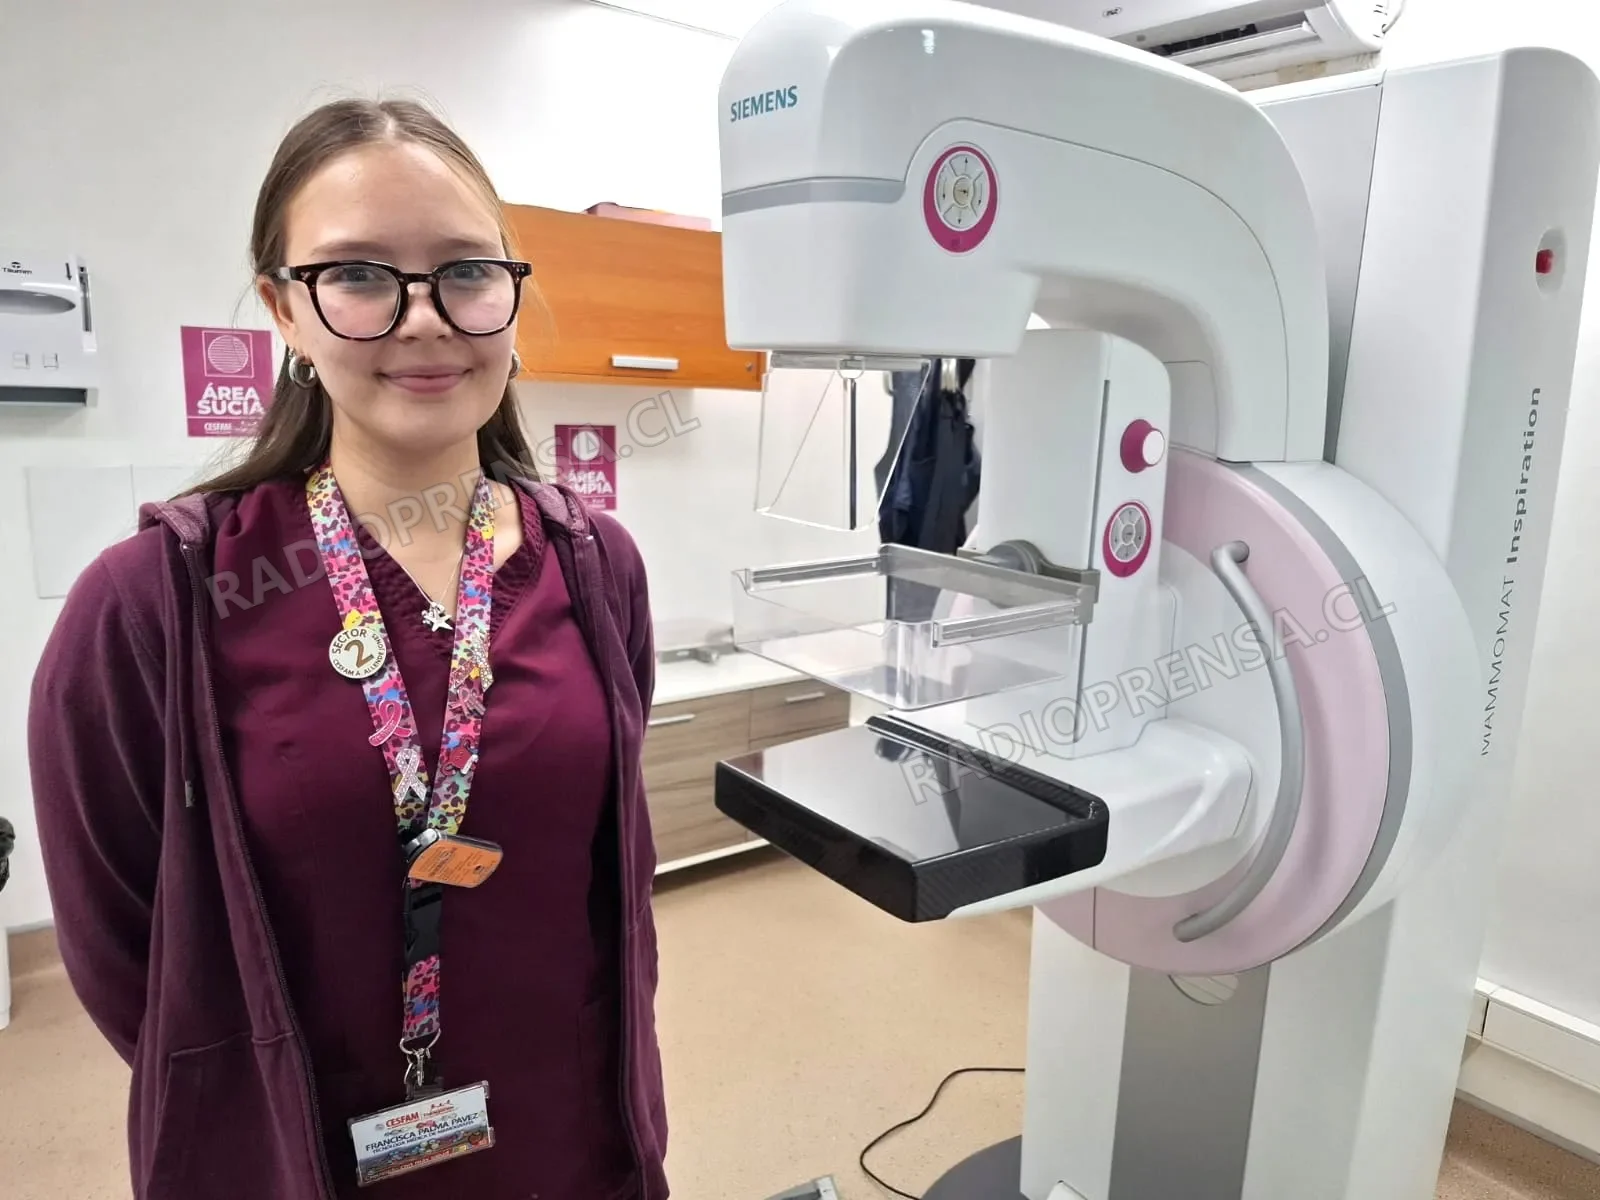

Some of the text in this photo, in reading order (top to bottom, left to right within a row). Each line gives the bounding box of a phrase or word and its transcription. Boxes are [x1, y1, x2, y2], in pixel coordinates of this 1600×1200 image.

[730, 85, 797, 123] SIEMENS
[201, 381, 261, 401] ÁREA
[196, 400, 266, 416] SUCIA
[1481, 387, 1541, 757] MAMMOMAT Inspiration
[331, 628, 367, 654] SECTOR
[344, 639, 374, 668] 2
[333, 659, 355, 676] CESFAM
[364, 652, 384, 675] ALLENDE
[365, 1112, 479, 1152] FRANCISCA PALMA PAVEZ
[385, 1111, 419, 1128] CESFAM
